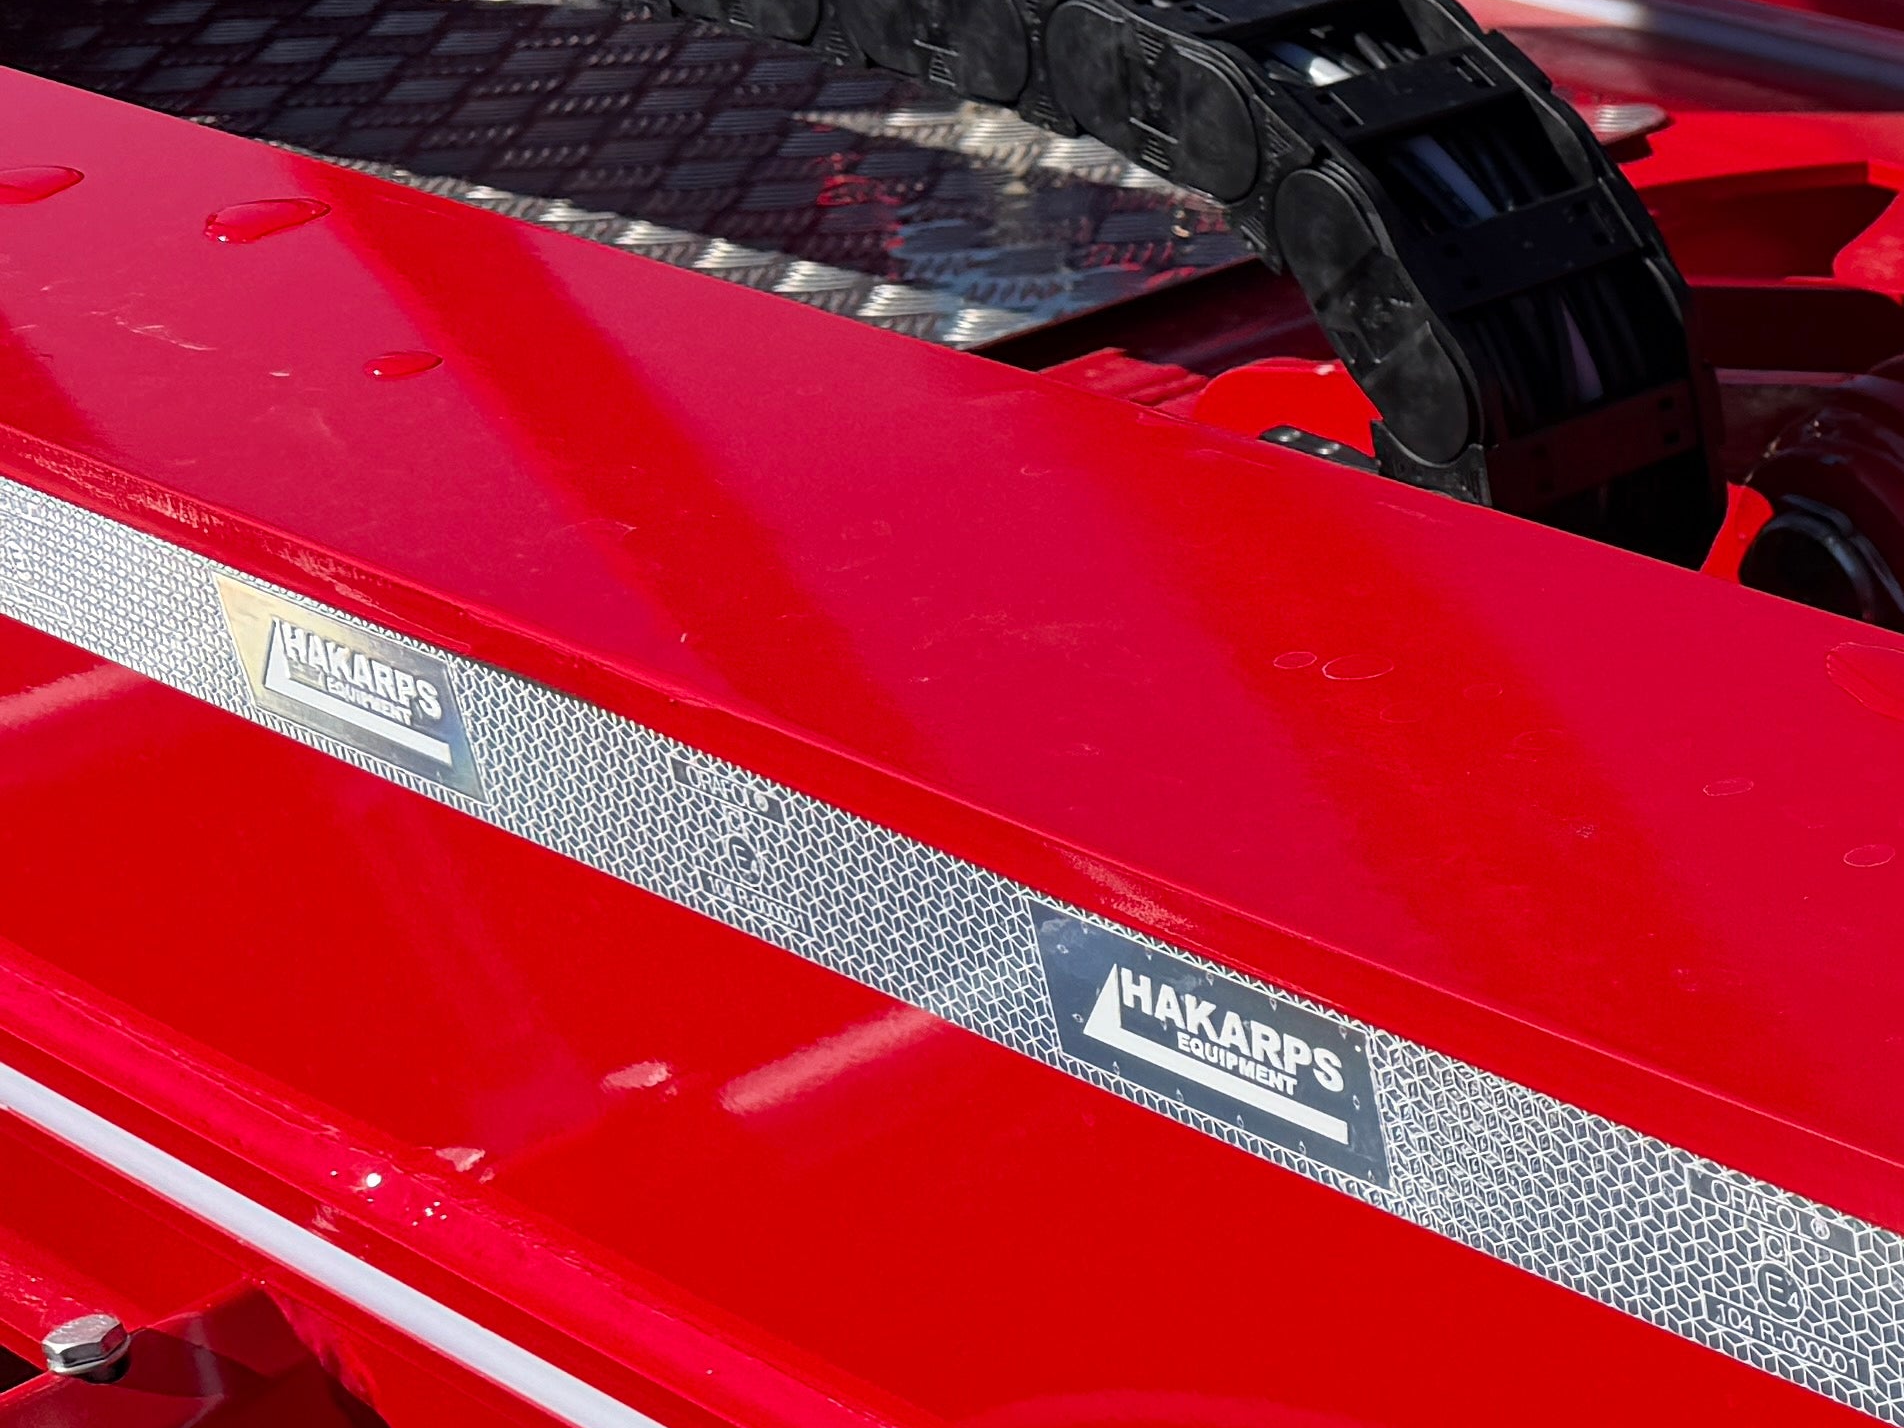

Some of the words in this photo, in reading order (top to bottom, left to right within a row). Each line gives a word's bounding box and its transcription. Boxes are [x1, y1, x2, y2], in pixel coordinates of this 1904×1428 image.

[282, 622, 442, 721] HAKARPS
[326, 676, 413, 726] EQUIPMENT
[1120, 968, 1345, 1093] HAKARPS
[1177, 1030, 1298, 1097] EQUIPMENT
[1716, 1303, 1755, 1336] 104
